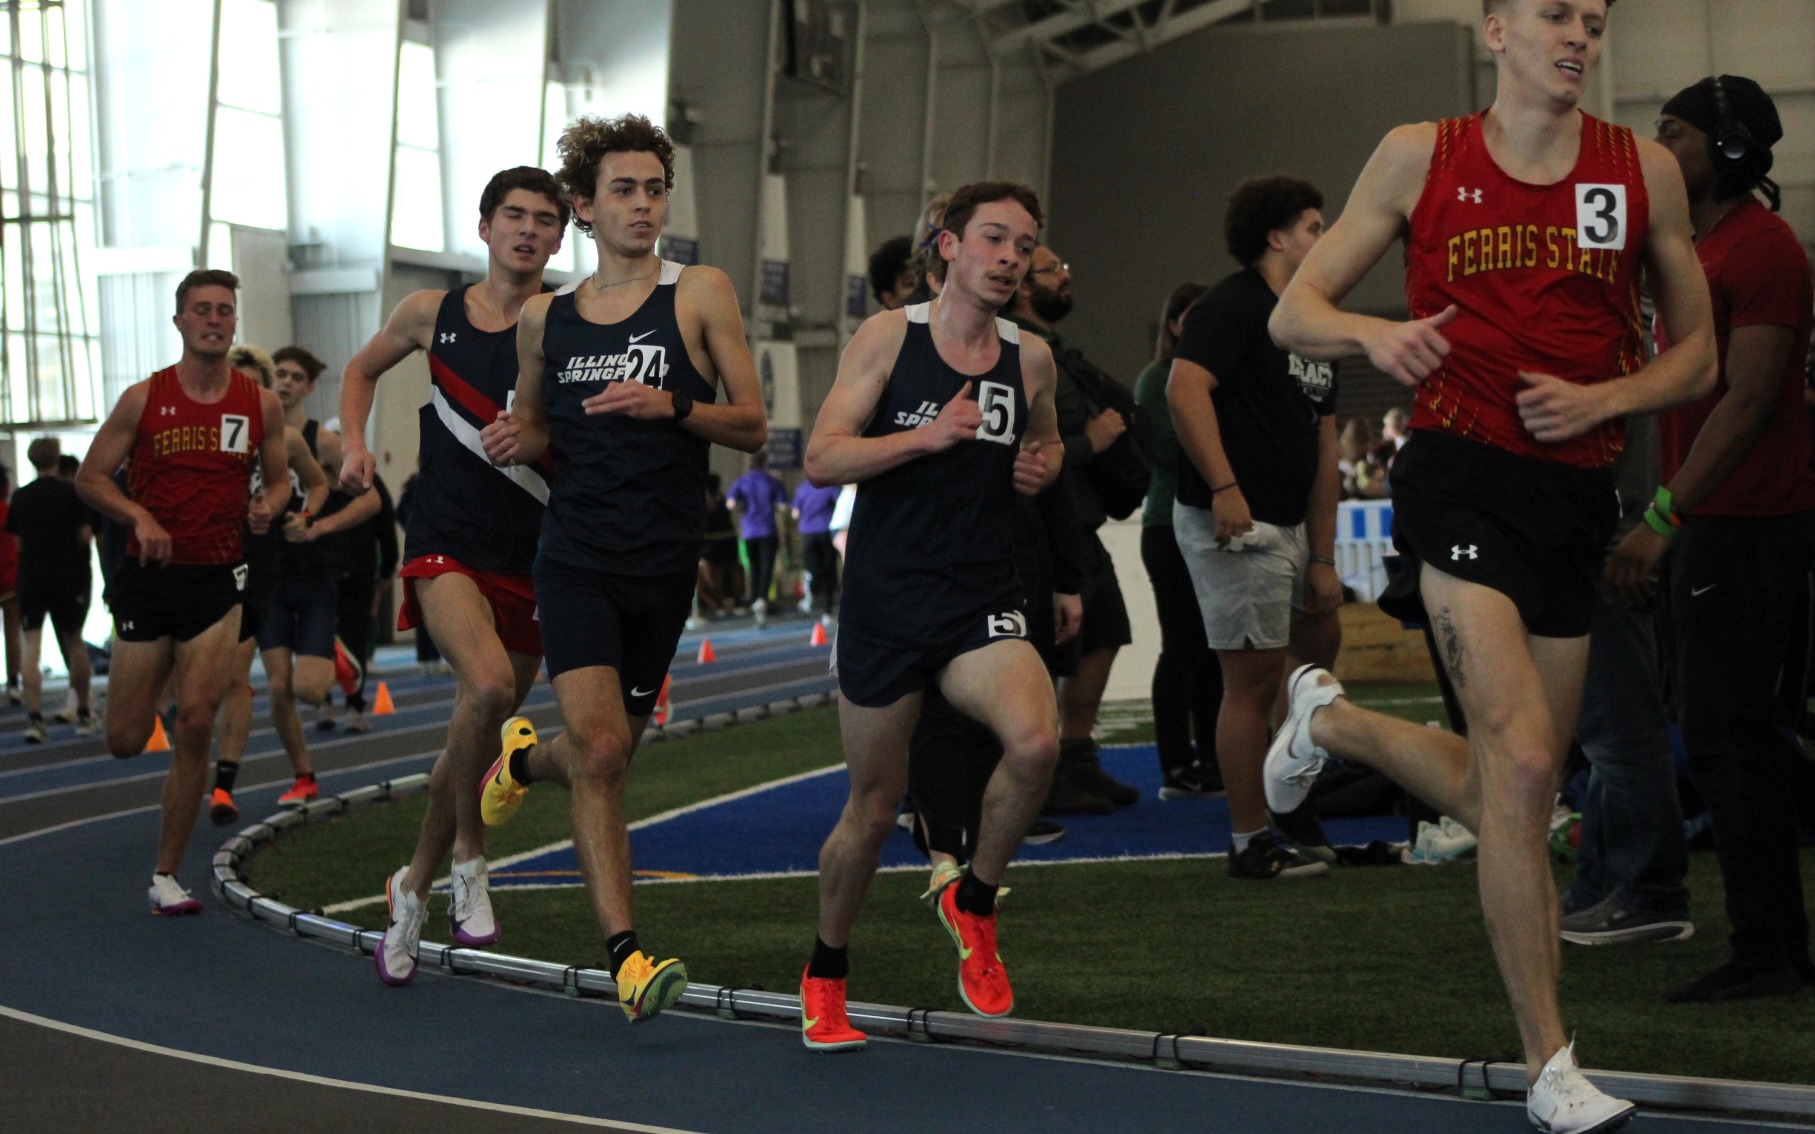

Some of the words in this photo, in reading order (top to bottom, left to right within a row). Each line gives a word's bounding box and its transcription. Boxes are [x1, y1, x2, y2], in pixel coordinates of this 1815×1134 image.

[1583, 188, 1619, 244] 3
[1447, 224, 1538, 283] FERRIS
[626, 348, 662, 389] 24
[224, 417, 245, 449] 7
[982, 385, 1009, 437] 5
[153, 426, 206, 459] FERRIS
